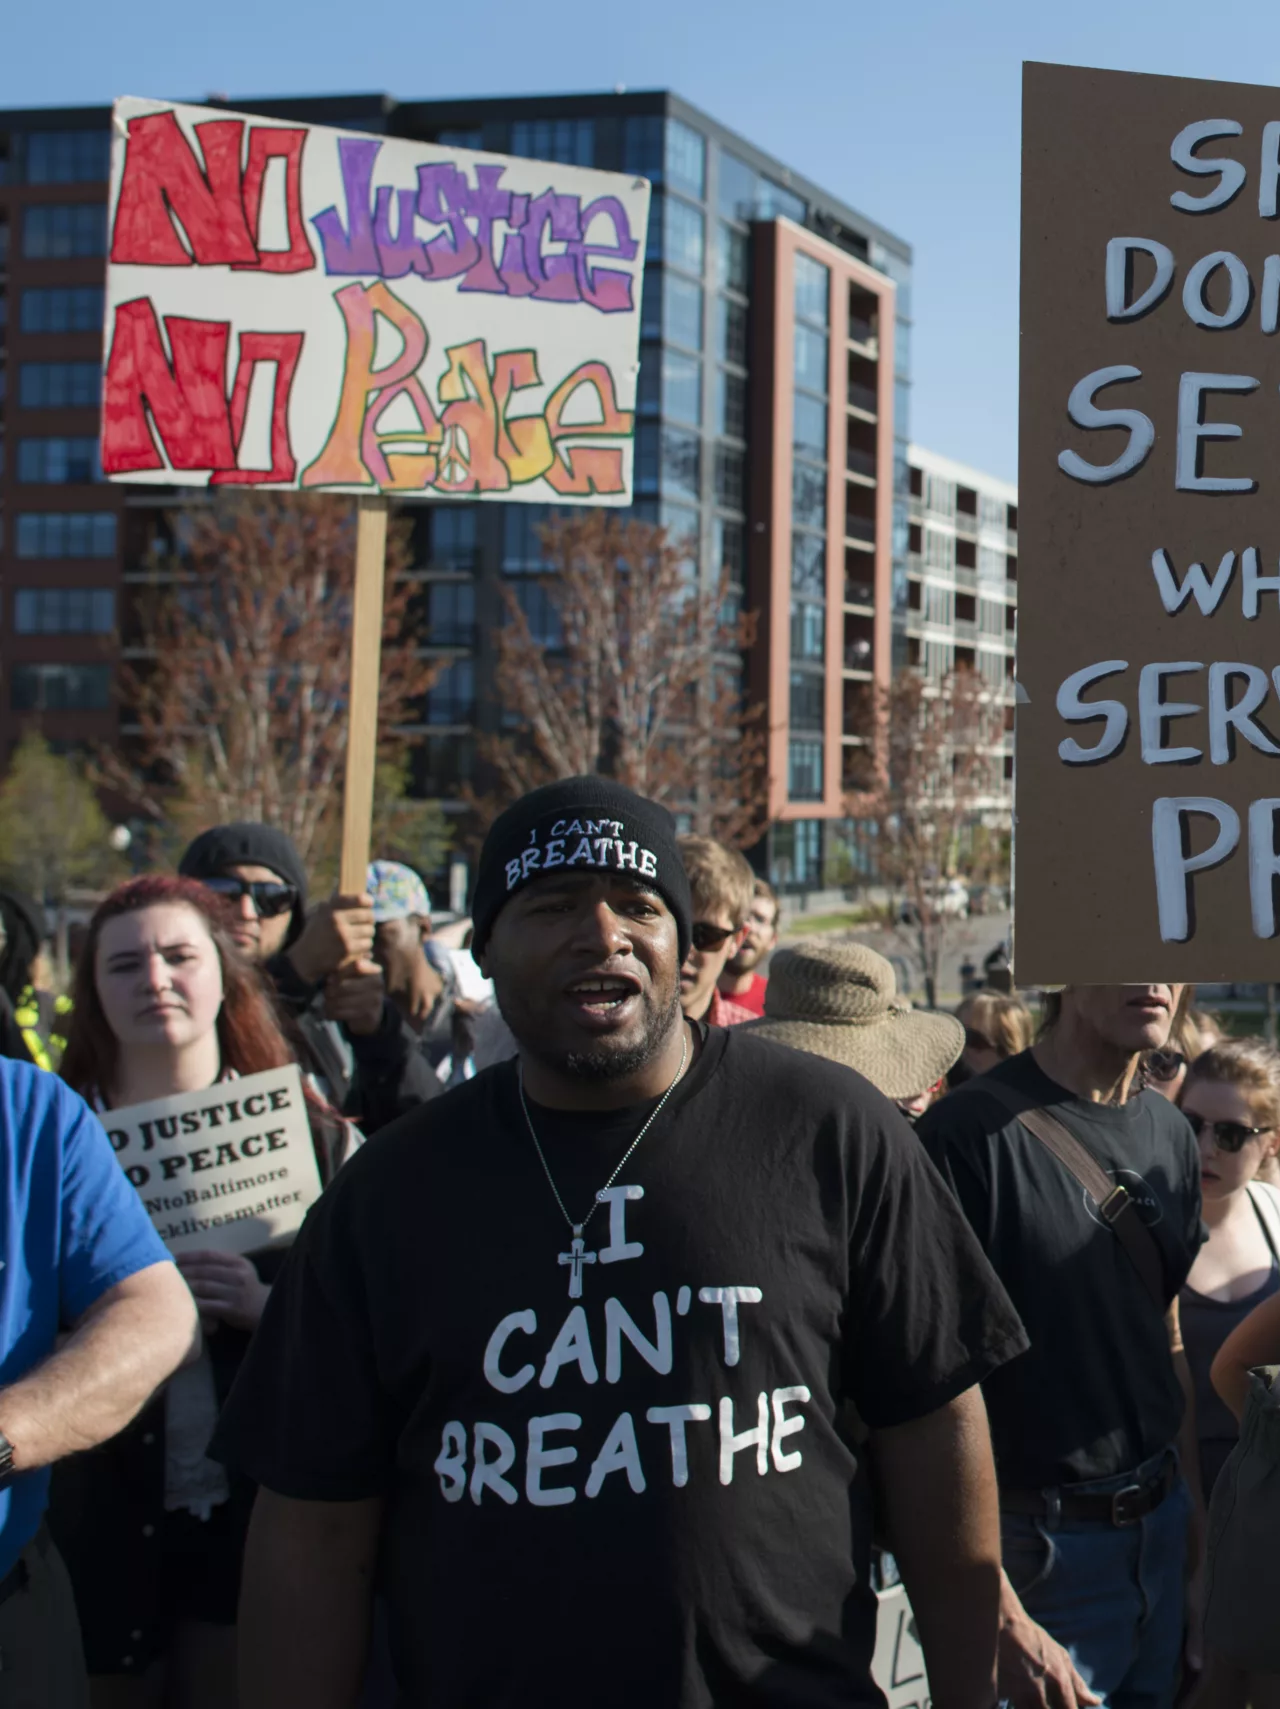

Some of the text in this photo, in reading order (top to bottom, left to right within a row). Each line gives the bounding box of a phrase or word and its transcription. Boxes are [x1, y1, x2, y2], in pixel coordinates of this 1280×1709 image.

[110, 110, 316, 274] NO
[102, 296, 306, 486] NO
[505, 837, 658, 891] BREATHE
[550, 818, 624, 838] CAN'T
[106, 1088, 291, 1152] O JUSTICE
[126, 1128, 288, 1188] O PEACE
[596, 1184, 645, 1264] I
[482, 1285, 764, 1395] CAN'T
[433, 1384, 812, 1507] BREATHE
